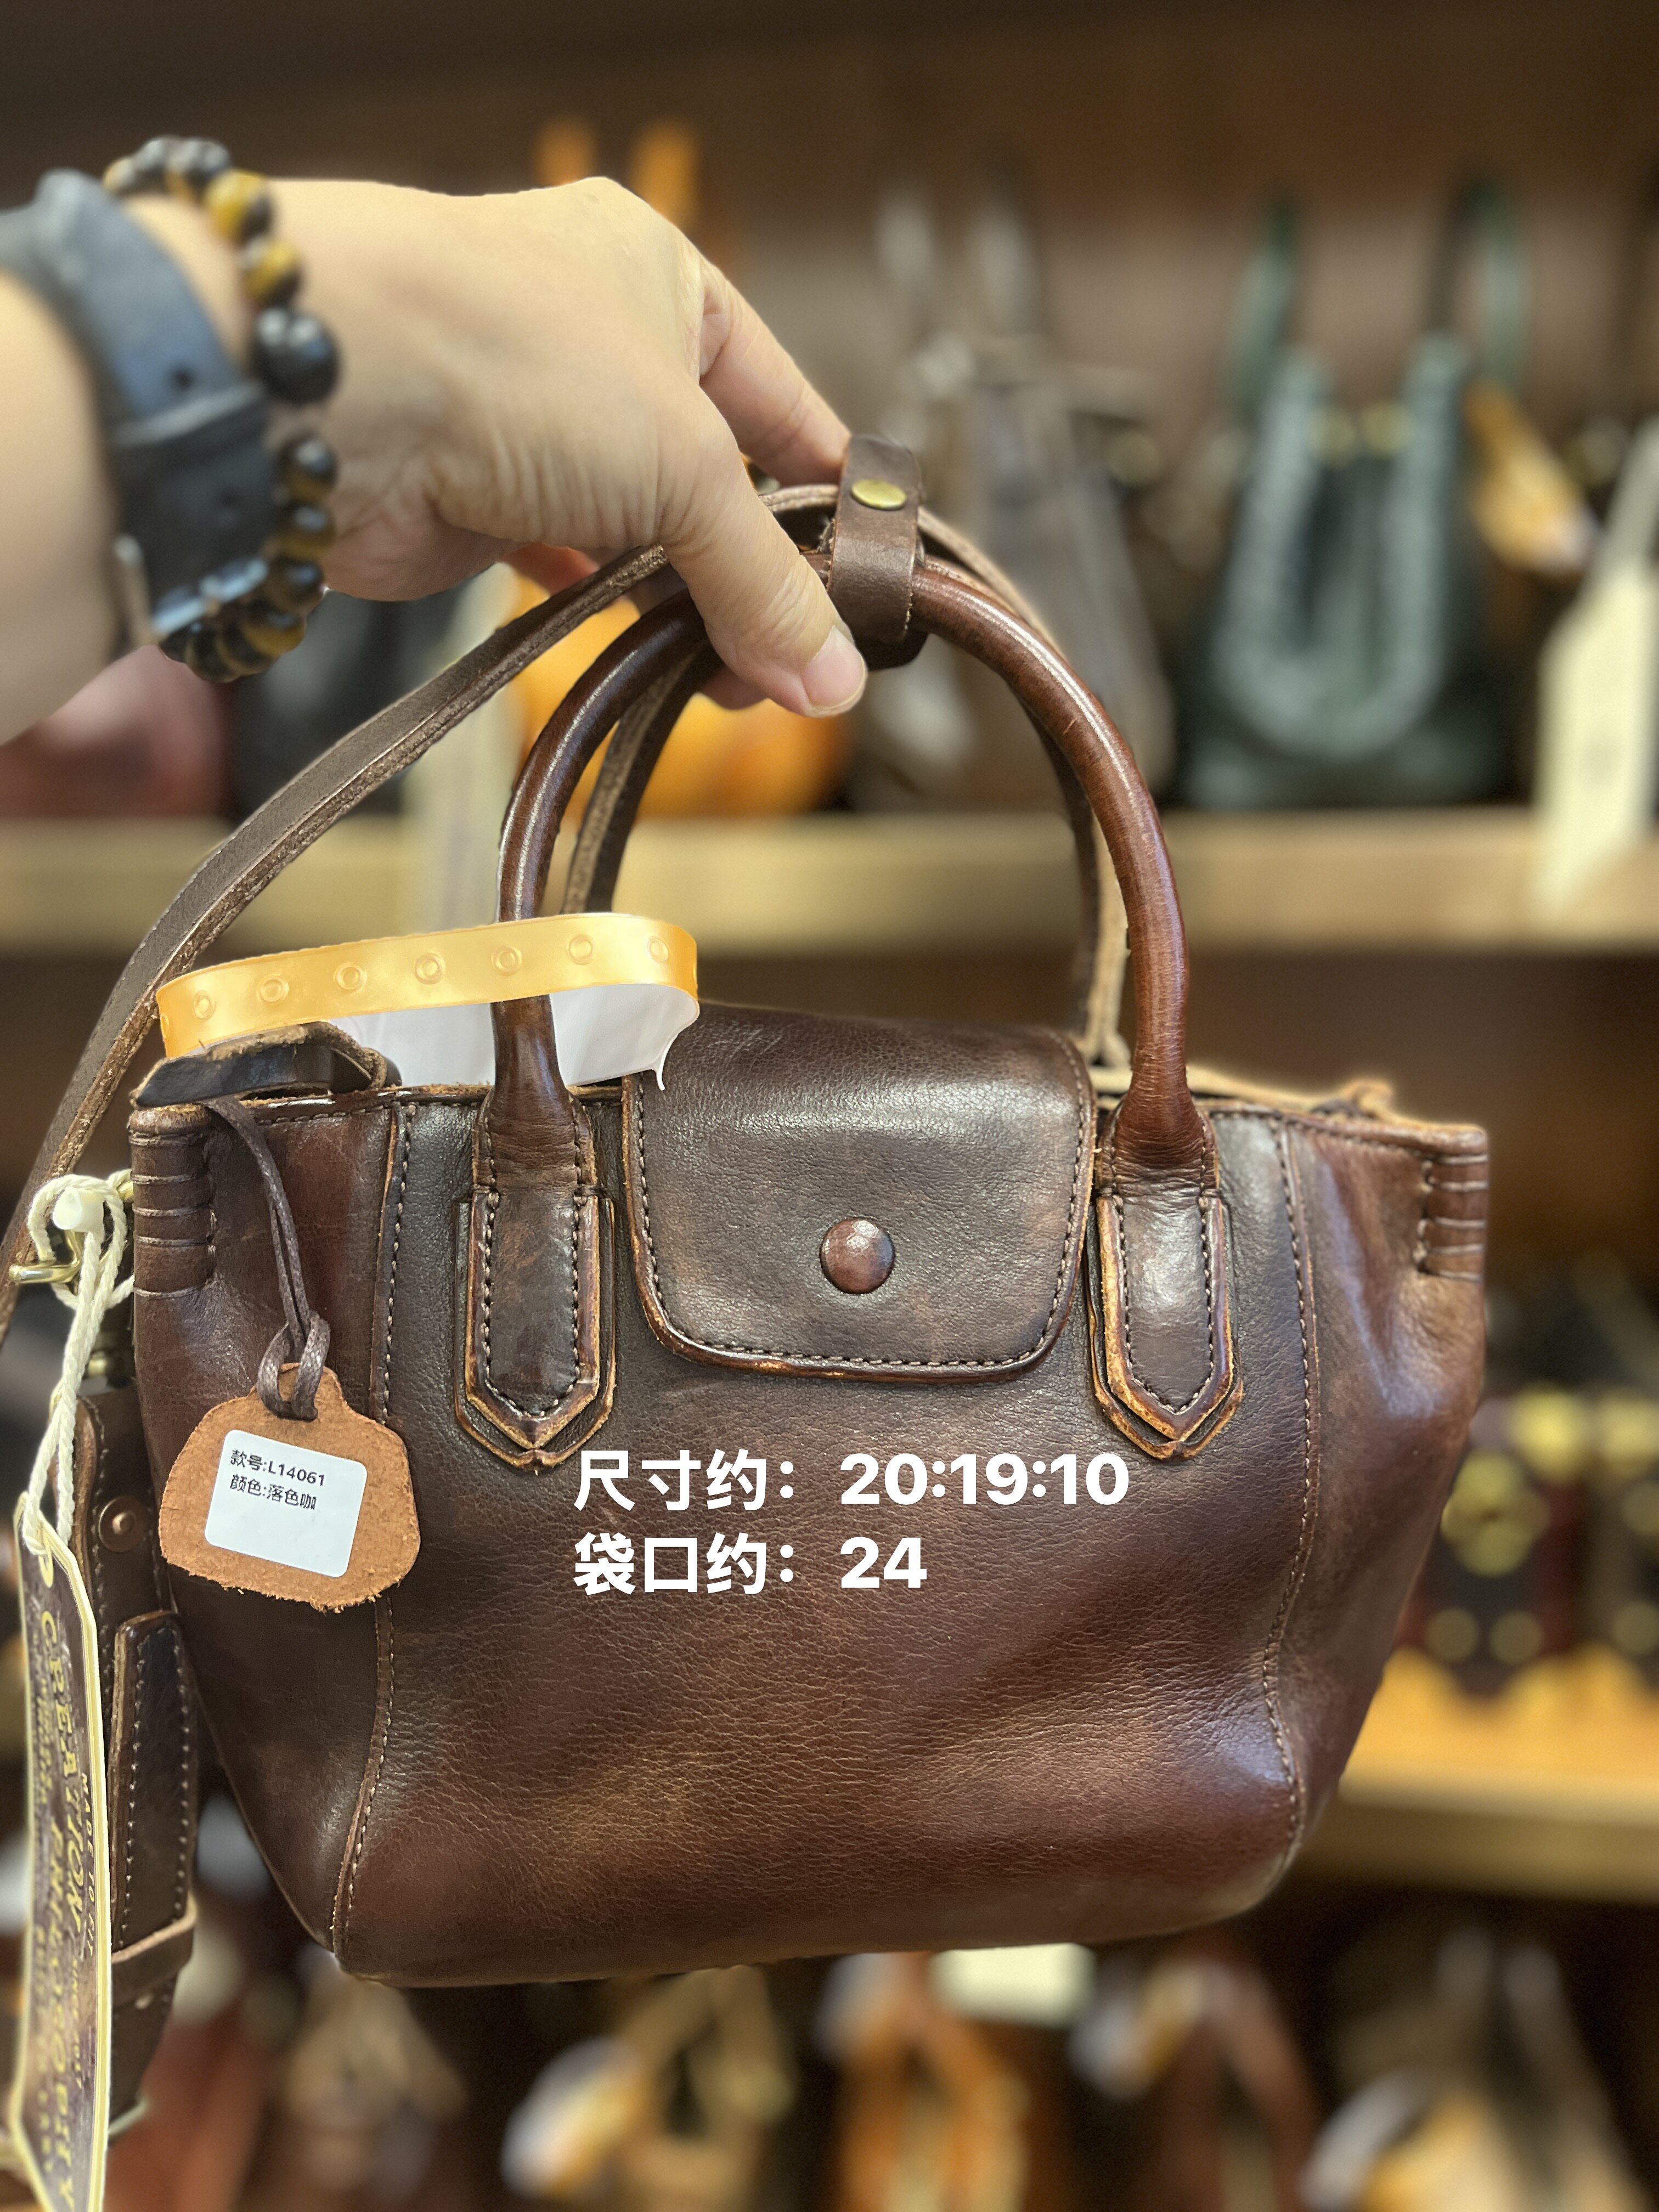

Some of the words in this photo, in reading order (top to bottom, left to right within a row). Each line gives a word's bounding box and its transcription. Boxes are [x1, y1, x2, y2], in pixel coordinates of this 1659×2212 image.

[230, 1449, 326, 1486] 款号:L14061
[230, 1474, 317, 1510] 颜色:落色咖
[41, 1611, 83, 1932] CREATION
[82, 1773, 94, 1858] MADE
[87, 1871, 94, 1903] TO
[86, 1913, 94, 1957] FIT
